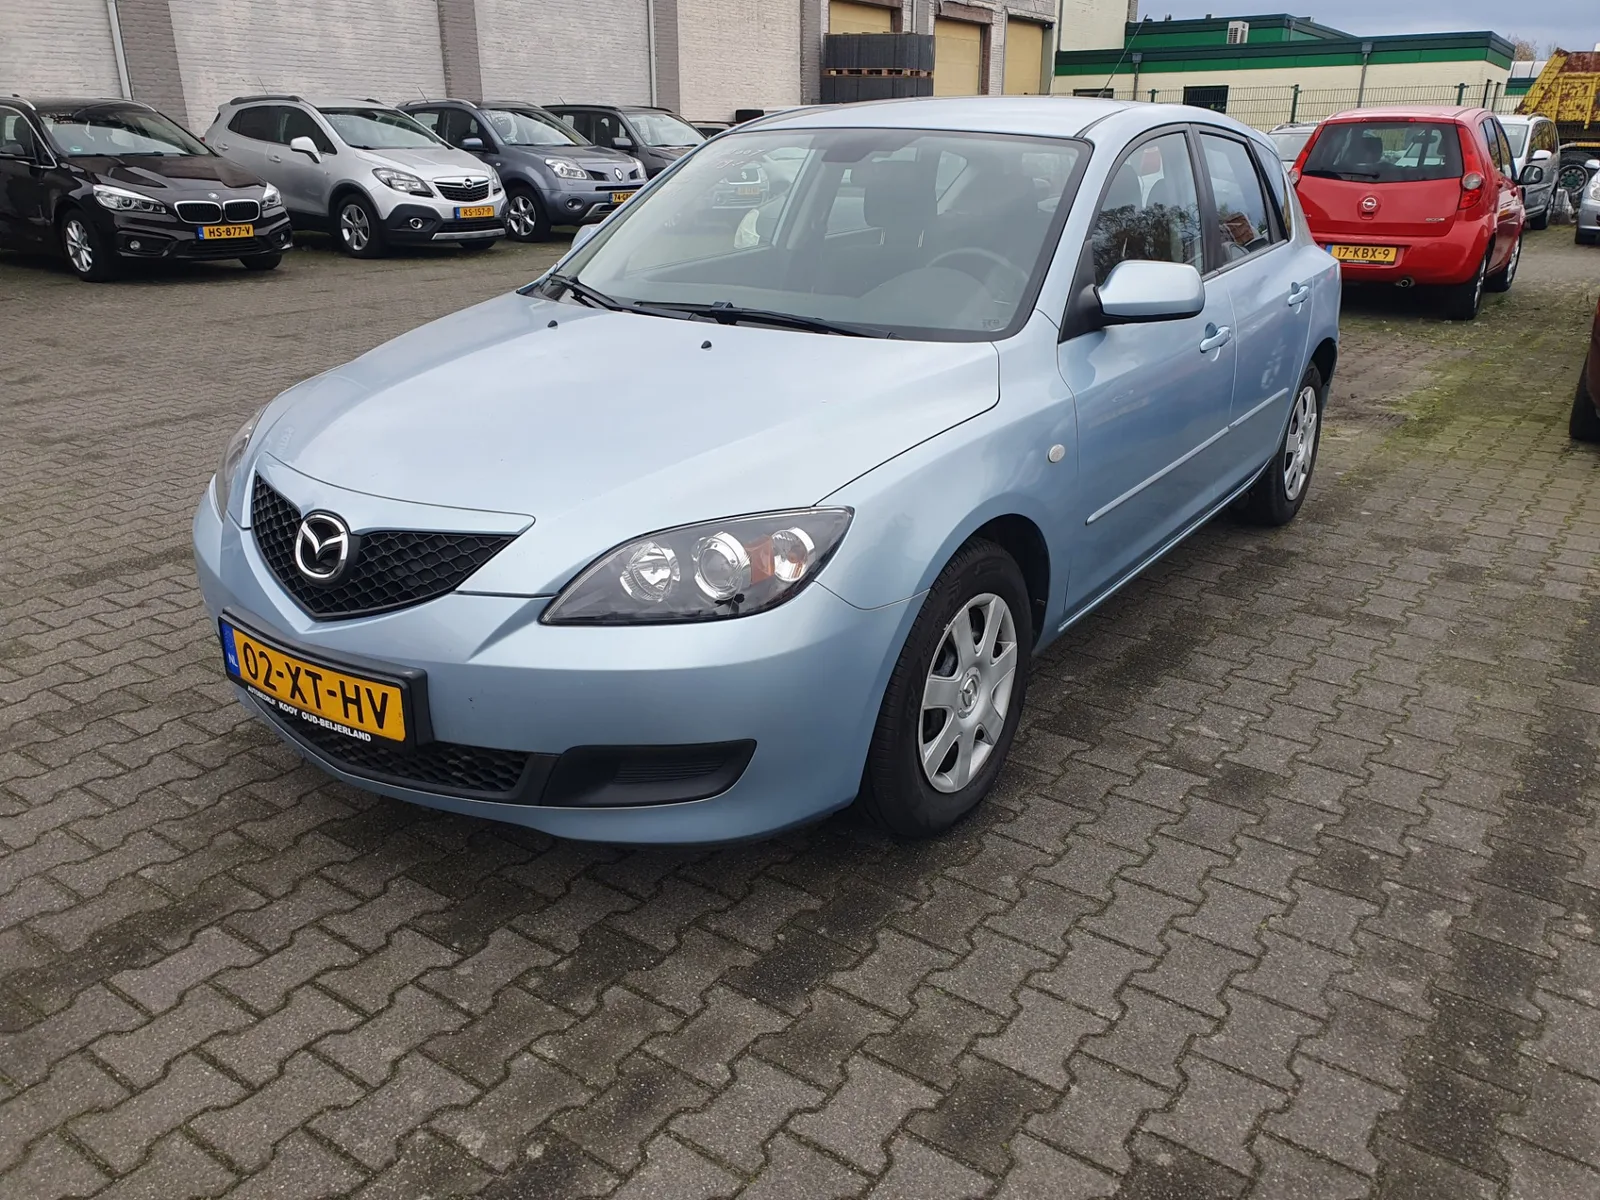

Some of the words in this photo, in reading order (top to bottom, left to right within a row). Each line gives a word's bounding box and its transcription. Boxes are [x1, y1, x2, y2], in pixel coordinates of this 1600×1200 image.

[463, 207, 492, 217] RS-157-P
[208, 226, 251, 238] HS-877-V
[1337, 246, 1391, 260] 17-KBX-9
[228, 653, 239, 668] NL
[243, 641, 389, 730] 02-XT-HV
[278, 701, 298, 717] KOOY
[301, 711, 372, 743] OUD-BEIJERLAND
